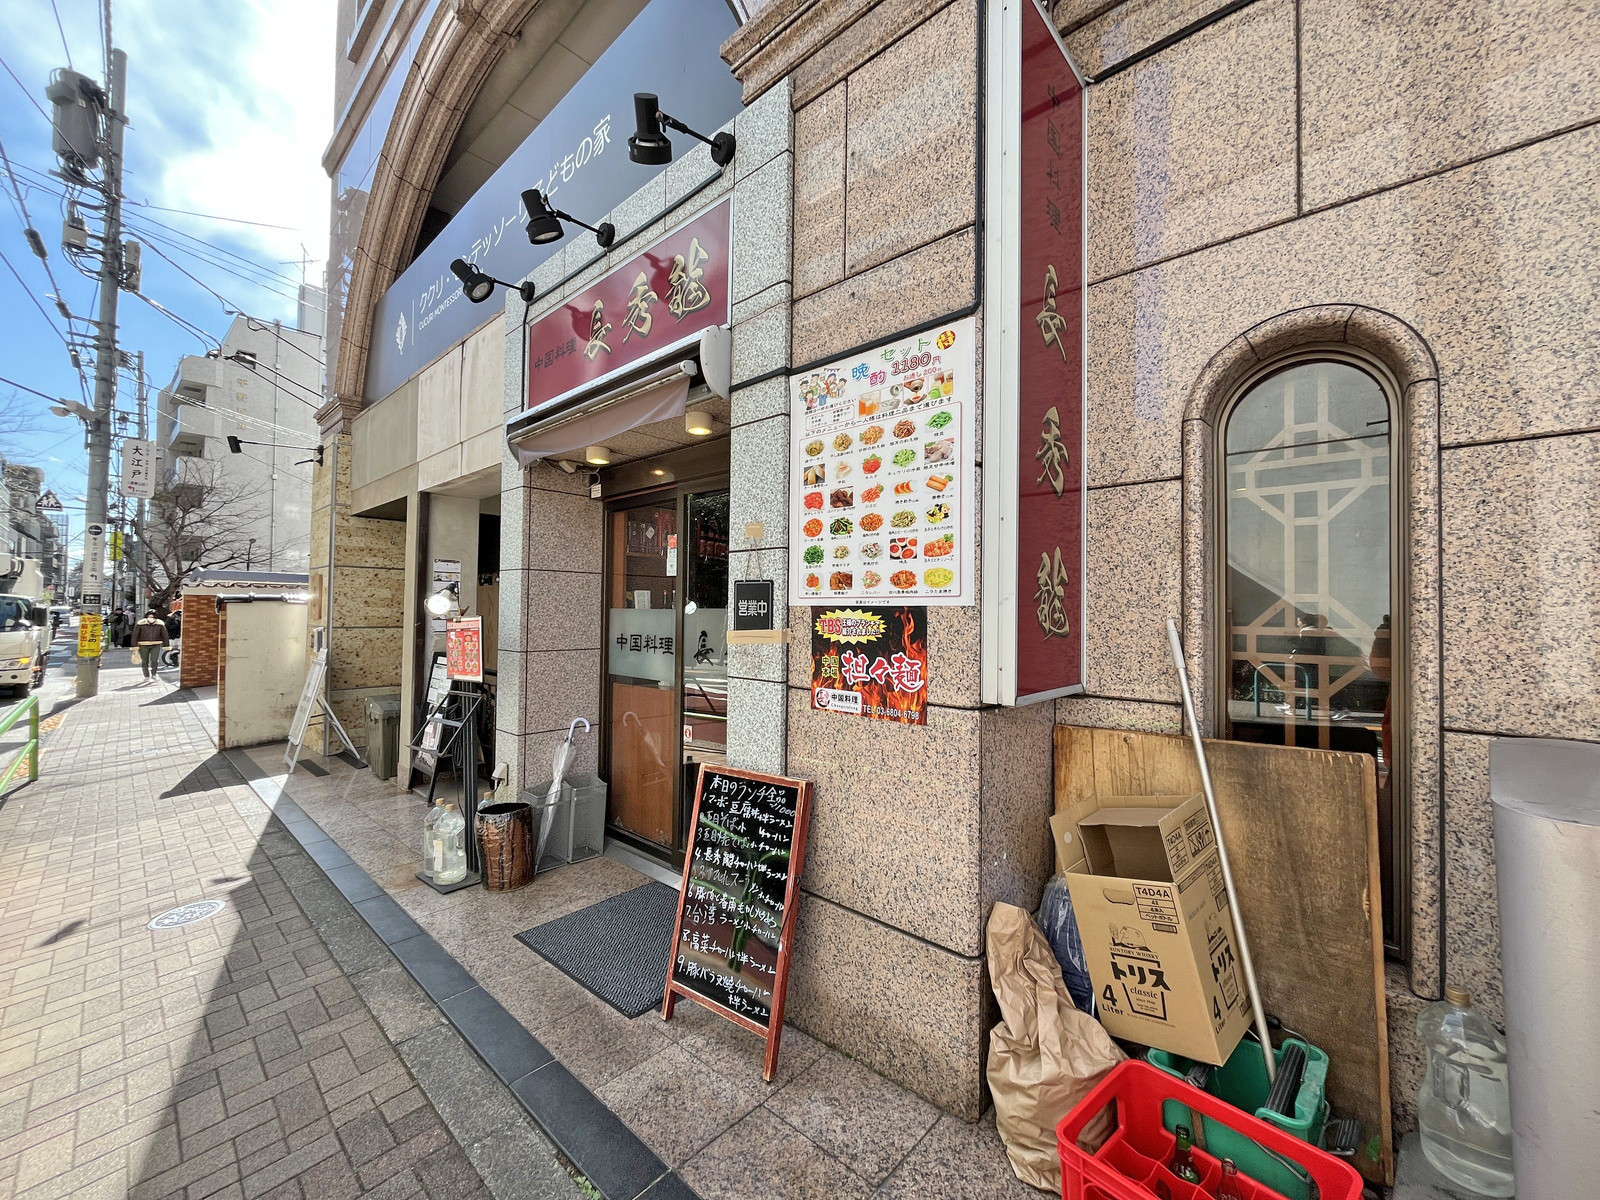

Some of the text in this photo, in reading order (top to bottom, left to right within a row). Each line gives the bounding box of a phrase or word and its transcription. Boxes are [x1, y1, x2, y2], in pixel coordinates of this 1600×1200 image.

[418, 313, 434, 331] CUCURI
[534, 338, 577, 370] 中国料理
[880, 338, 931, 362] セット
[852, 362, 888, 387] 晩酌
[131, 445, 144, 479] 大江戸
[738, 599, 768, 617] 営業中
[616, 630, 714, 667] 中国料理 長
[831, 693, 858, 704] 中国料理
[1135, 887, 1170, 899] T4D4A
[1135, 951, 1159, 960] WHISKY
[1211, 943, 1236, 984] トリス
[1111, 961, 1171, 992] トリス
[1102, 984, 1118, 1007] 4
[1130, 986, 1158, 999] classic
[1102, 1003, 1124, 1016] Liter
[1213, 995, 1222, 1021] 4
